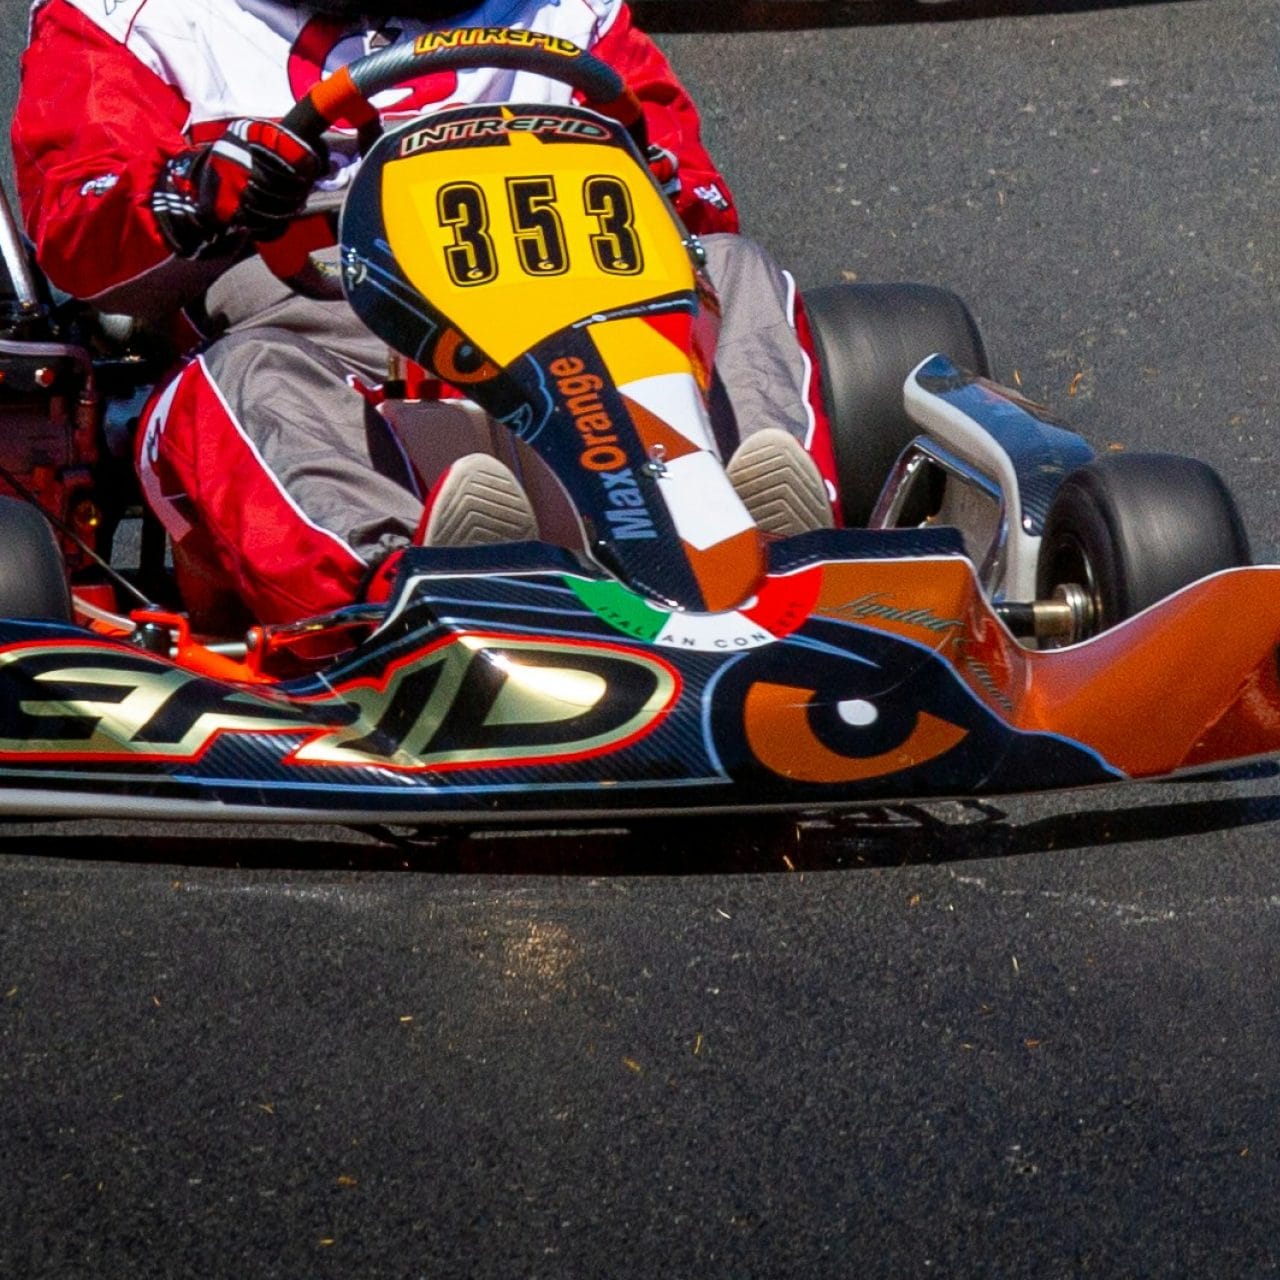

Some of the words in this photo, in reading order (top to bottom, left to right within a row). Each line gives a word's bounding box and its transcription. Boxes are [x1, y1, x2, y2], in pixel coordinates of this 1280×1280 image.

[413, 27, 582, 57] INTREPID
[401, 116, 612, 157] INTREPID
[436, 175, 645, 288] 353
